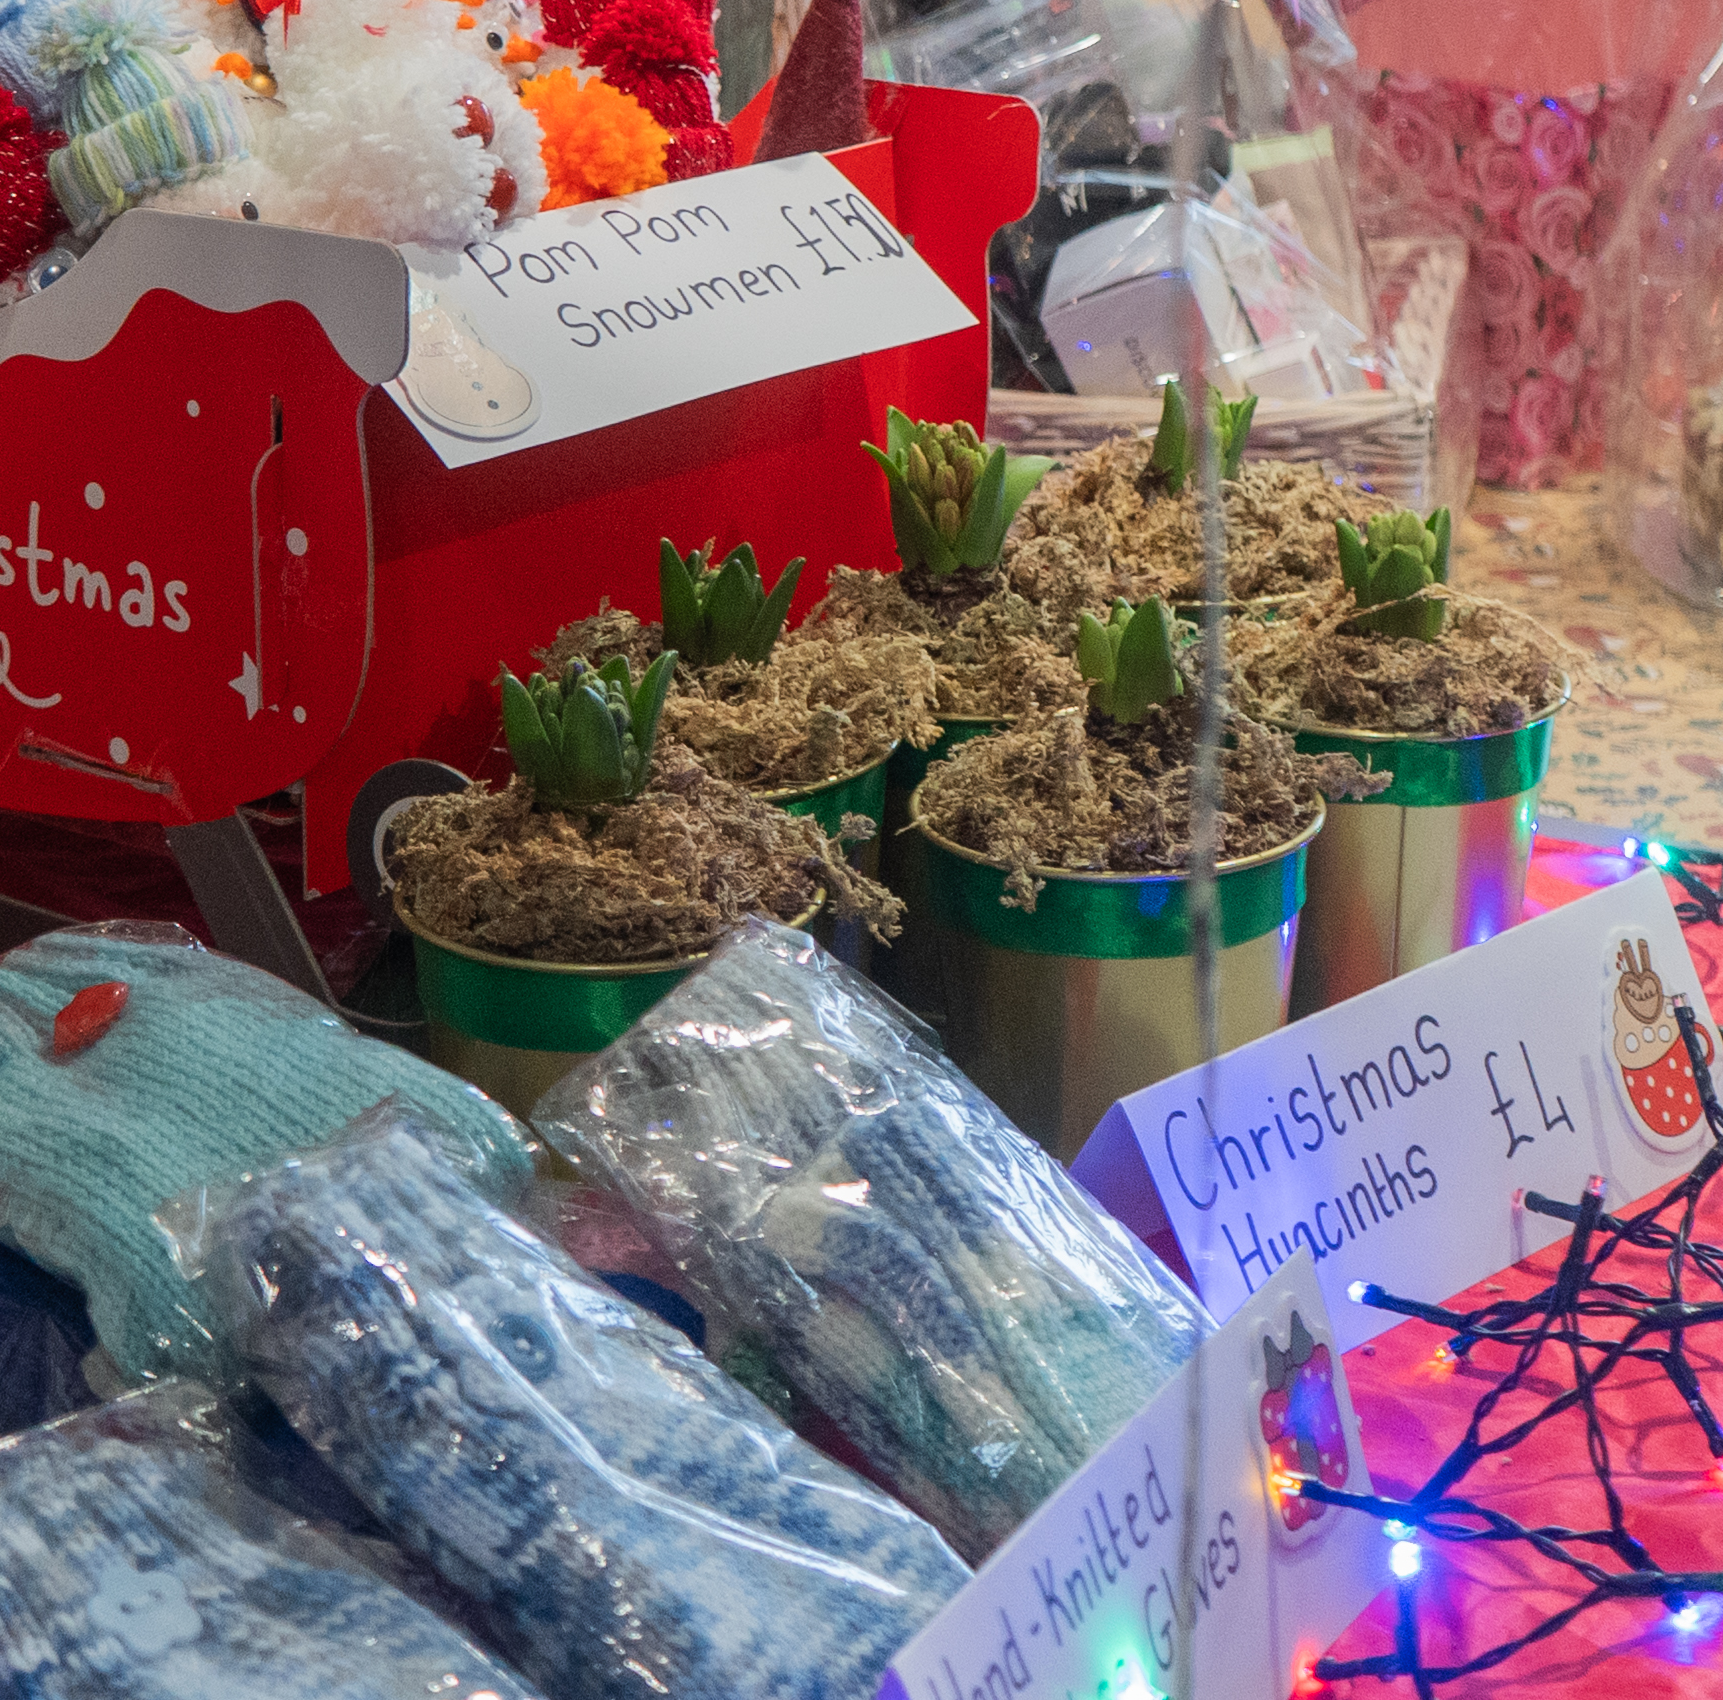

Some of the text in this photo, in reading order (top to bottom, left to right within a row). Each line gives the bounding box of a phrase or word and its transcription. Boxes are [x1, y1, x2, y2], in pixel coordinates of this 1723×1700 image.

[463, 202, 731, 298] Pom Pom
[555, 257, 802, 349] Snowmen
[1163, 1014, 1453, 1212] Christmas
[1483, 1040, 1577, 1160] £4
[1143, 1510, 1241, 1671] Glves
